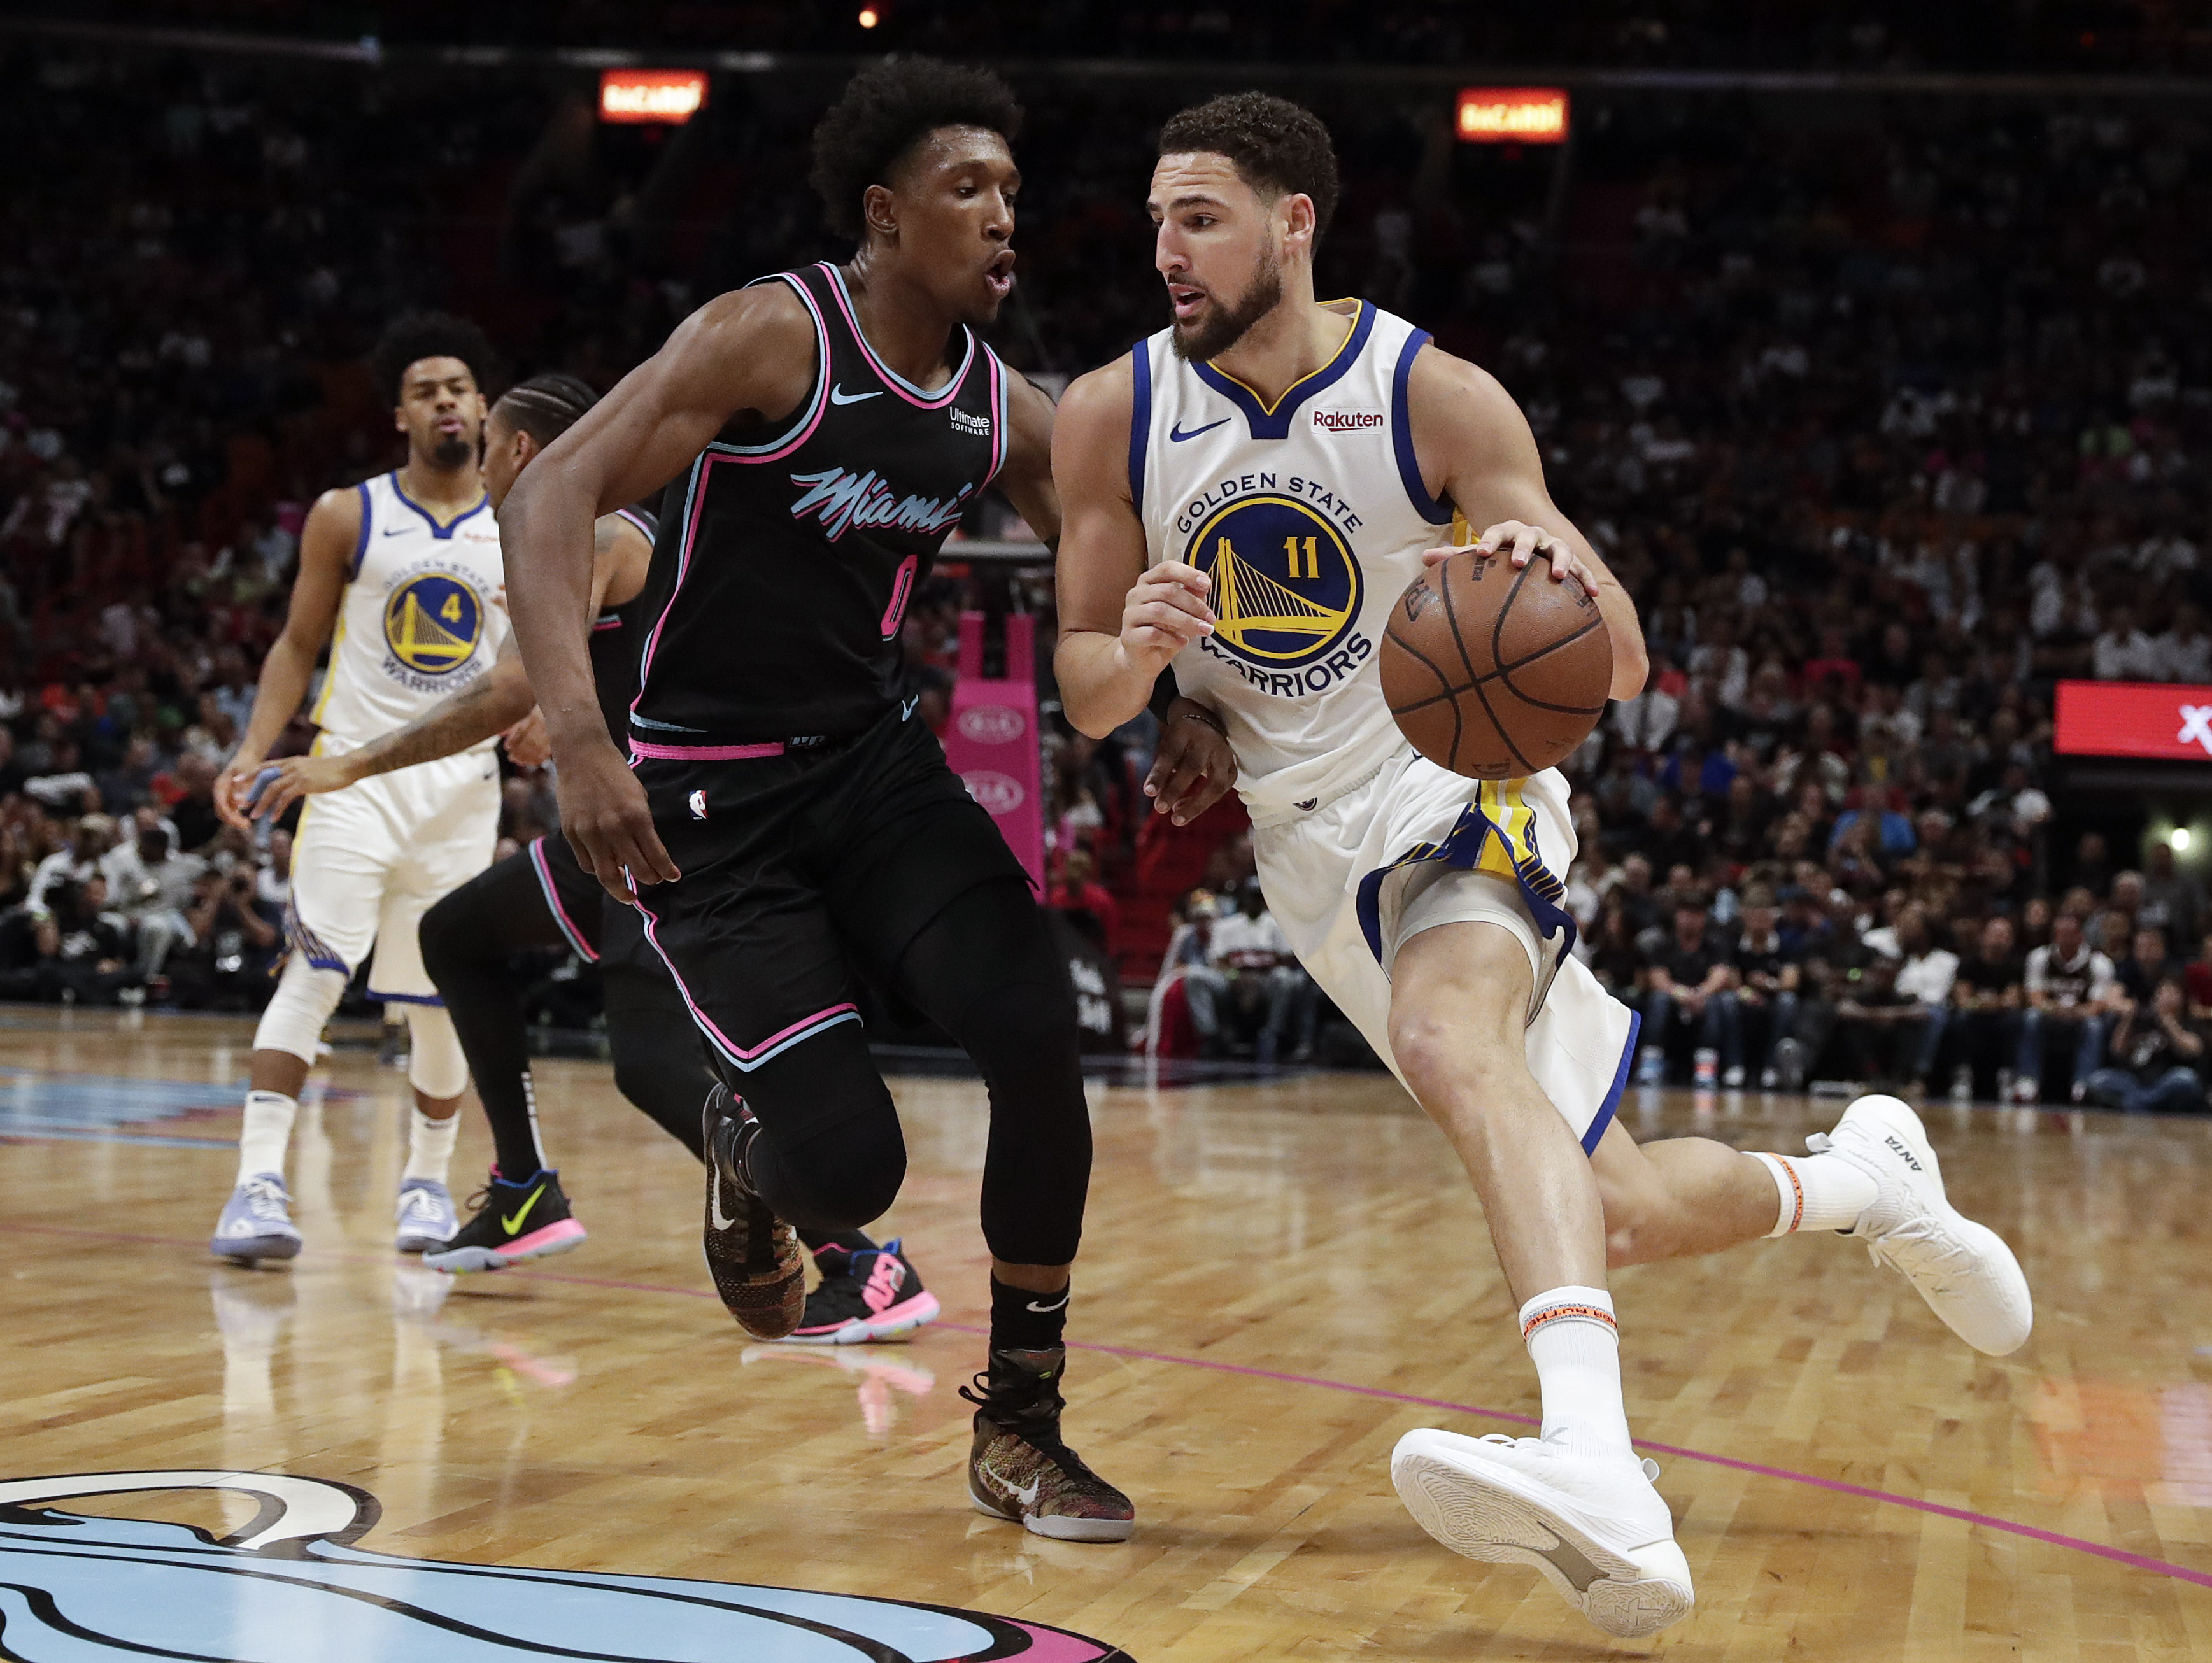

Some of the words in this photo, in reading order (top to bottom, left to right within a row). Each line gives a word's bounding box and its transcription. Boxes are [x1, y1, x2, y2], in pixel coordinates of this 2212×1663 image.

[949, 406, 990, 428] Ultimate
[951, 421, 989, 435] SOFTWARE
[1314, 411, 1384, 427] Rakuten
[790, 467, 973, 543] Miami
[1177, 473, 1277, 534] GOLDEN
[1289, 477, 1363, 534] STATE
[1283, 536, 1321, 579] 11
[440, 592, 463, 623] 4
[881, 554, 918, 642] 0
[1200, 632, 1372, 698] WARRIORS
[1885, 1136, 1922, 1171] ANTA
